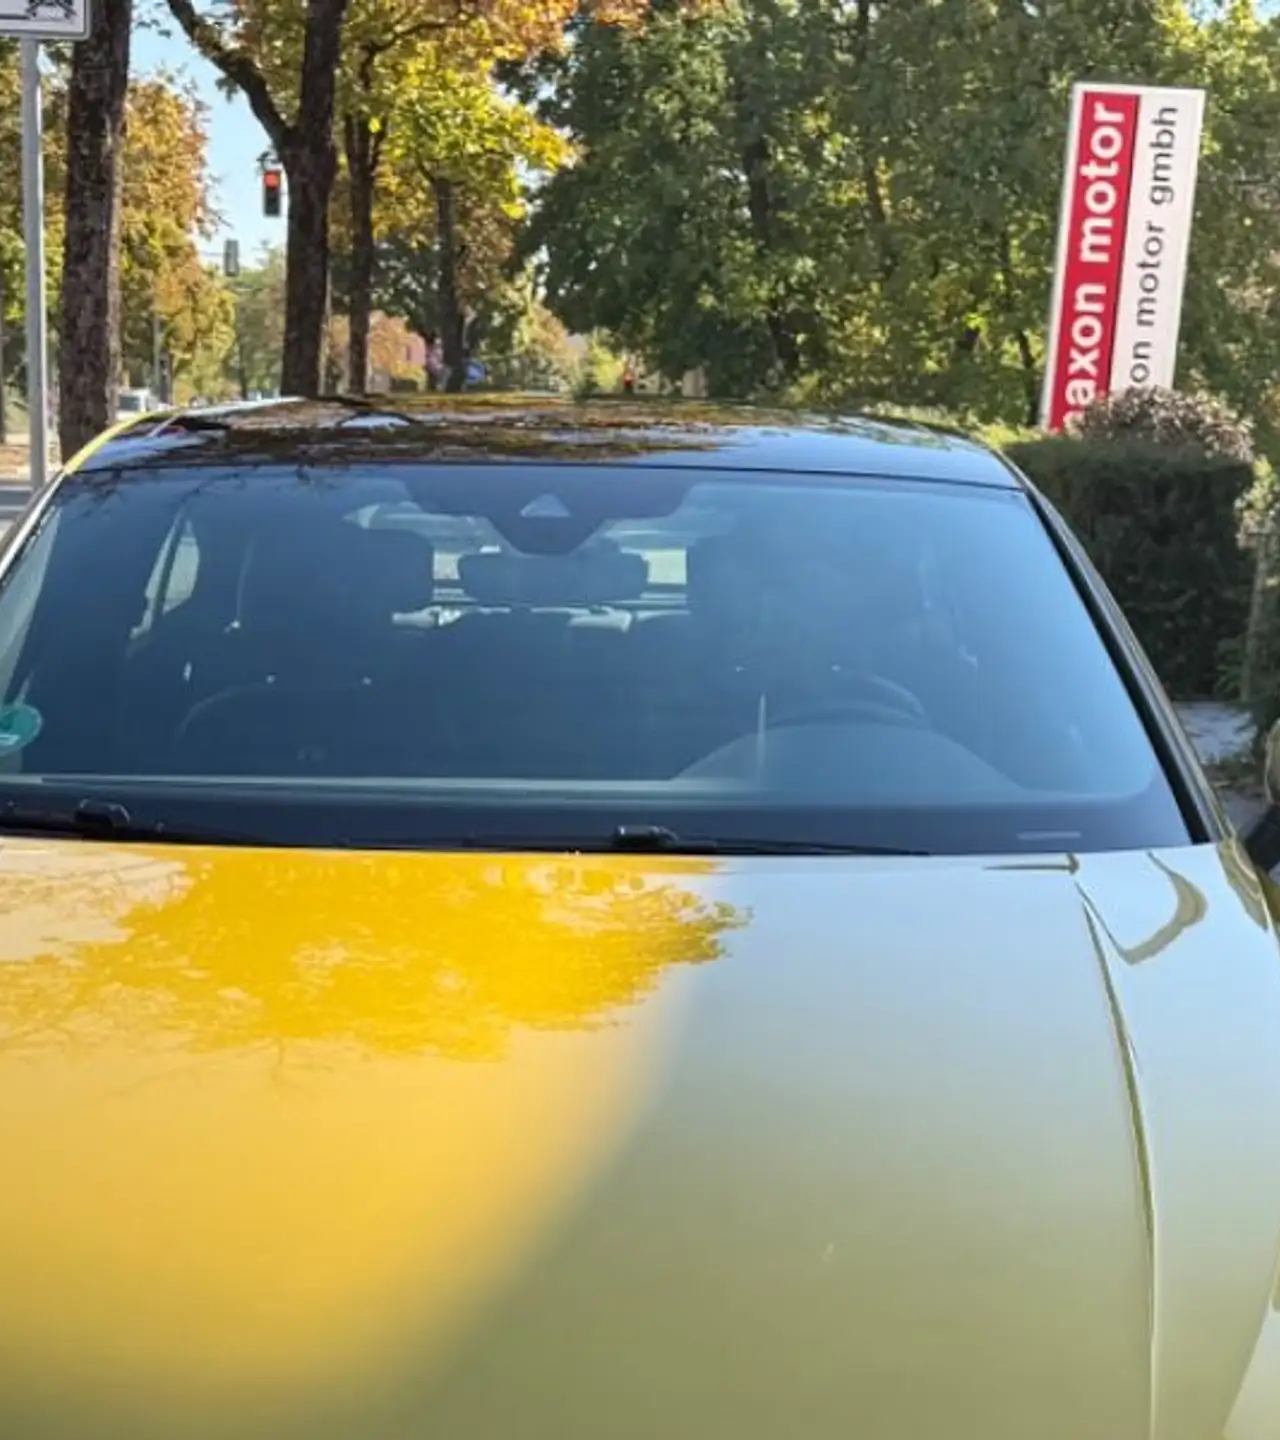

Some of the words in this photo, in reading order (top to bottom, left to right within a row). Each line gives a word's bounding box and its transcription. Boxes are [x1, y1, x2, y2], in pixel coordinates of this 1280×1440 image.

[1080, 102, 1125, 263] motor
[1149, 106, 1179, 206] gmbh
[1136, 221, 1166, 328] motor
